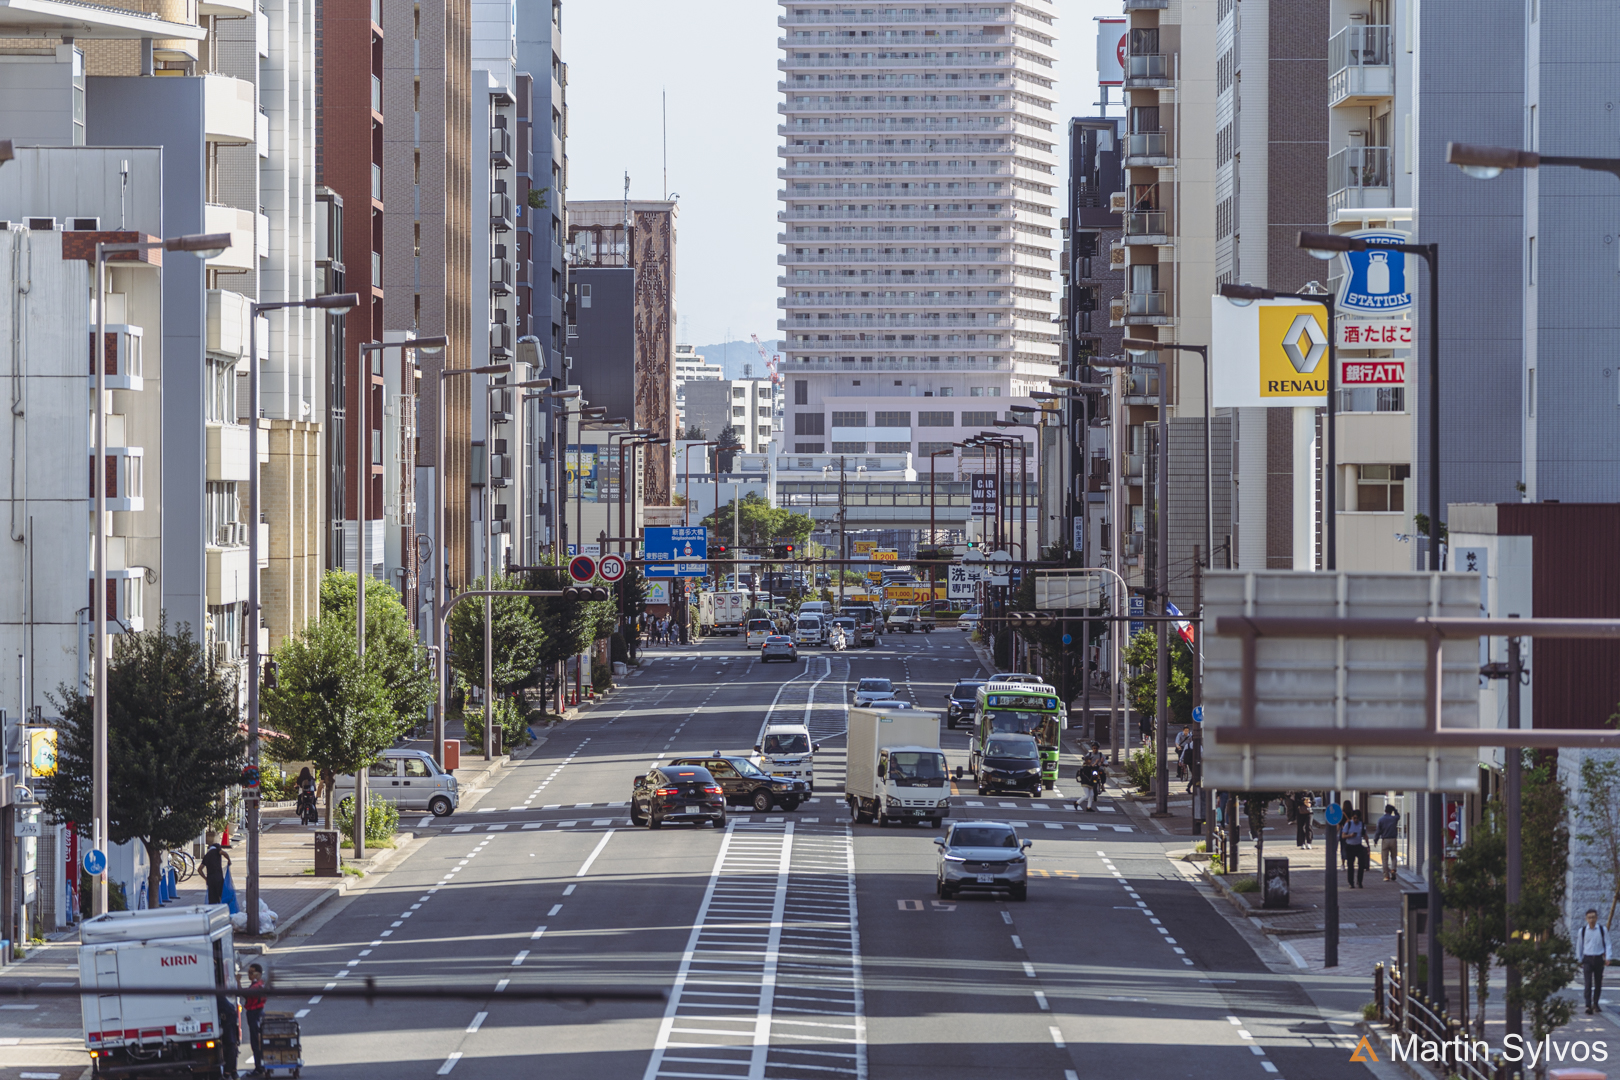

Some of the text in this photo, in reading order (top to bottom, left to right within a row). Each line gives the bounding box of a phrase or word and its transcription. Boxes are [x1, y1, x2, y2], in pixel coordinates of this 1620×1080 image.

[1348, 292, 1409, 307] STATION
[1268, 380, 1328, 392] RENAU
[977, 479, 994, 488] CAR
[973, 489, 996, 498] WASH
[604, 562, 619, 574] 50
[160, 954, 197, 967] KIRIN
